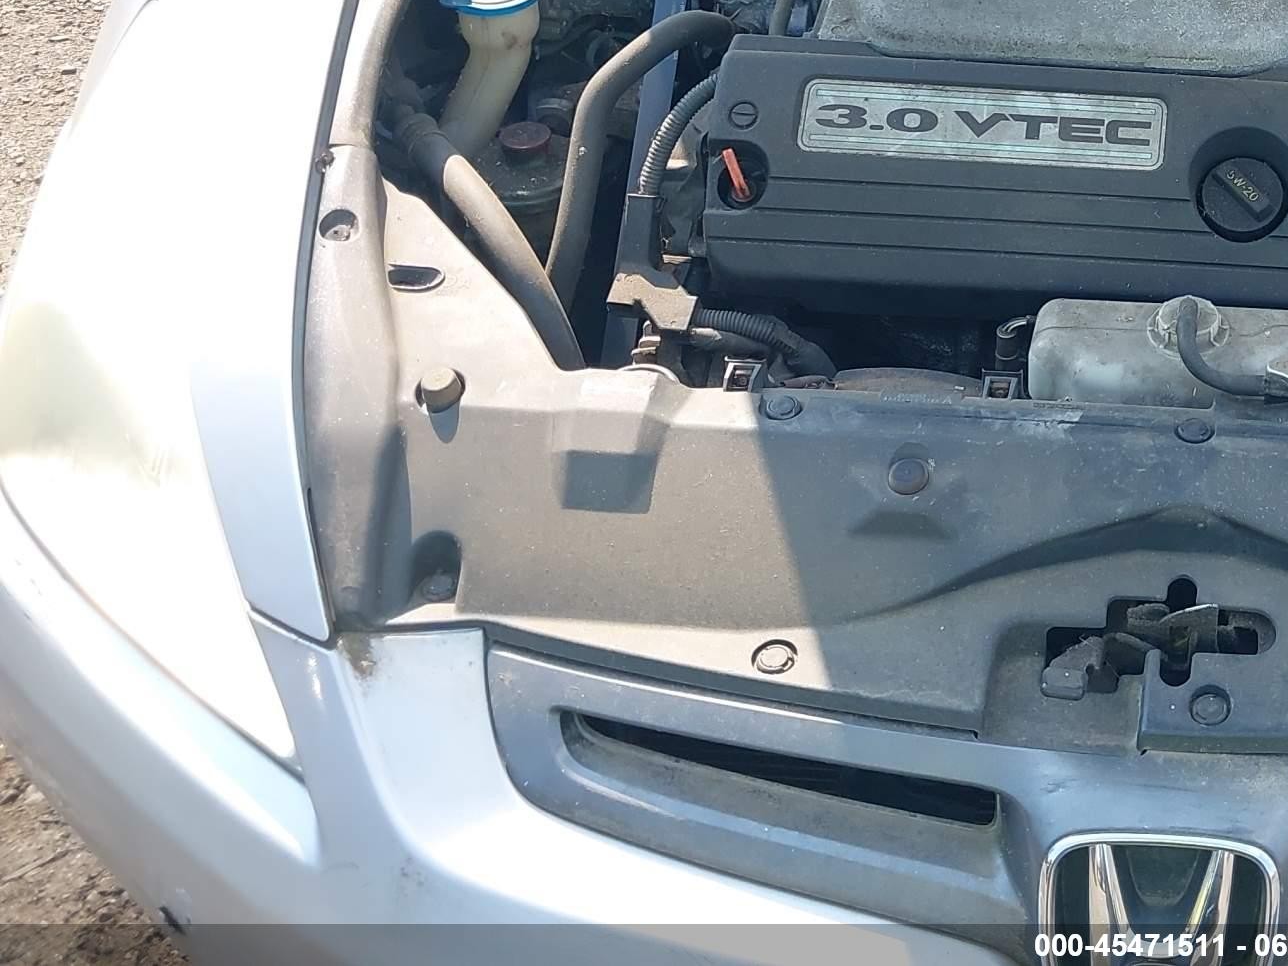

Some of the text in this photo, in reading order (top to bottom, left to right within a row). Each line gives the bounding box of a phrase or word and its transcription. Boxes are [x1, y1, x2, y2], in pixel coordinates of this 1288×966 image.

[815, 104, 1152, 147] 3.0 VTEC
[1226, 170, 1259, 202] 5W-20
